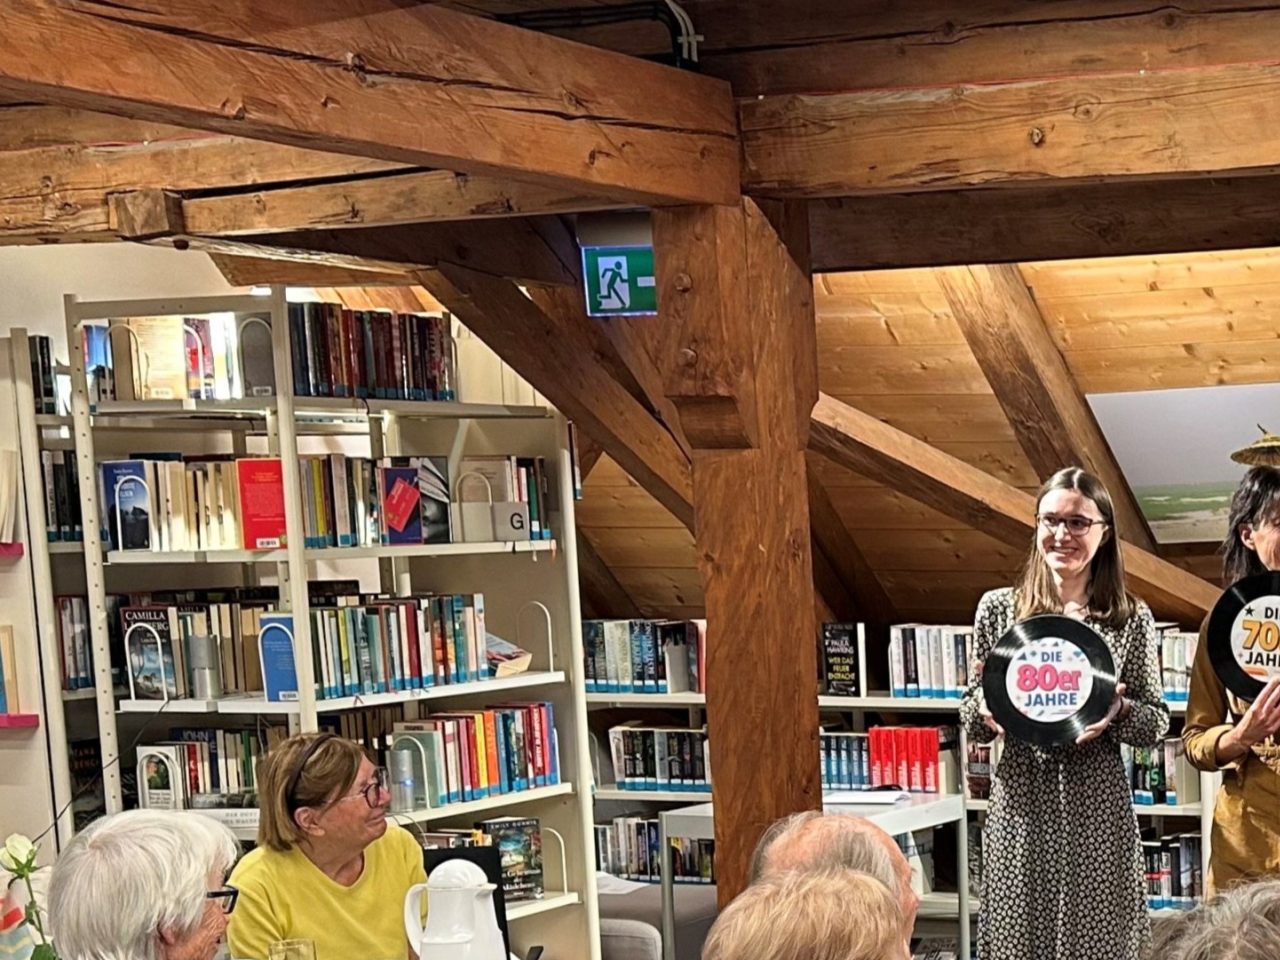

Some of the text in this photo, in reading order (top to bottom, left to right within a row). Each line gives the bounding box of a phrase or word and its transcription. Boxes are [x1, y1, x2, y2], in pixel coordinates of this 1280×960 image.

[510, 512, 524, 530] G
[125, 611, 167, 621] CAMILLA
[1040, 650, 1063, 664] DIE
[1016, 663, 1082, 692] 80er
[1024, 691, 1078, 708] JAHRE
[182, 730, 209, 742] JOHN
